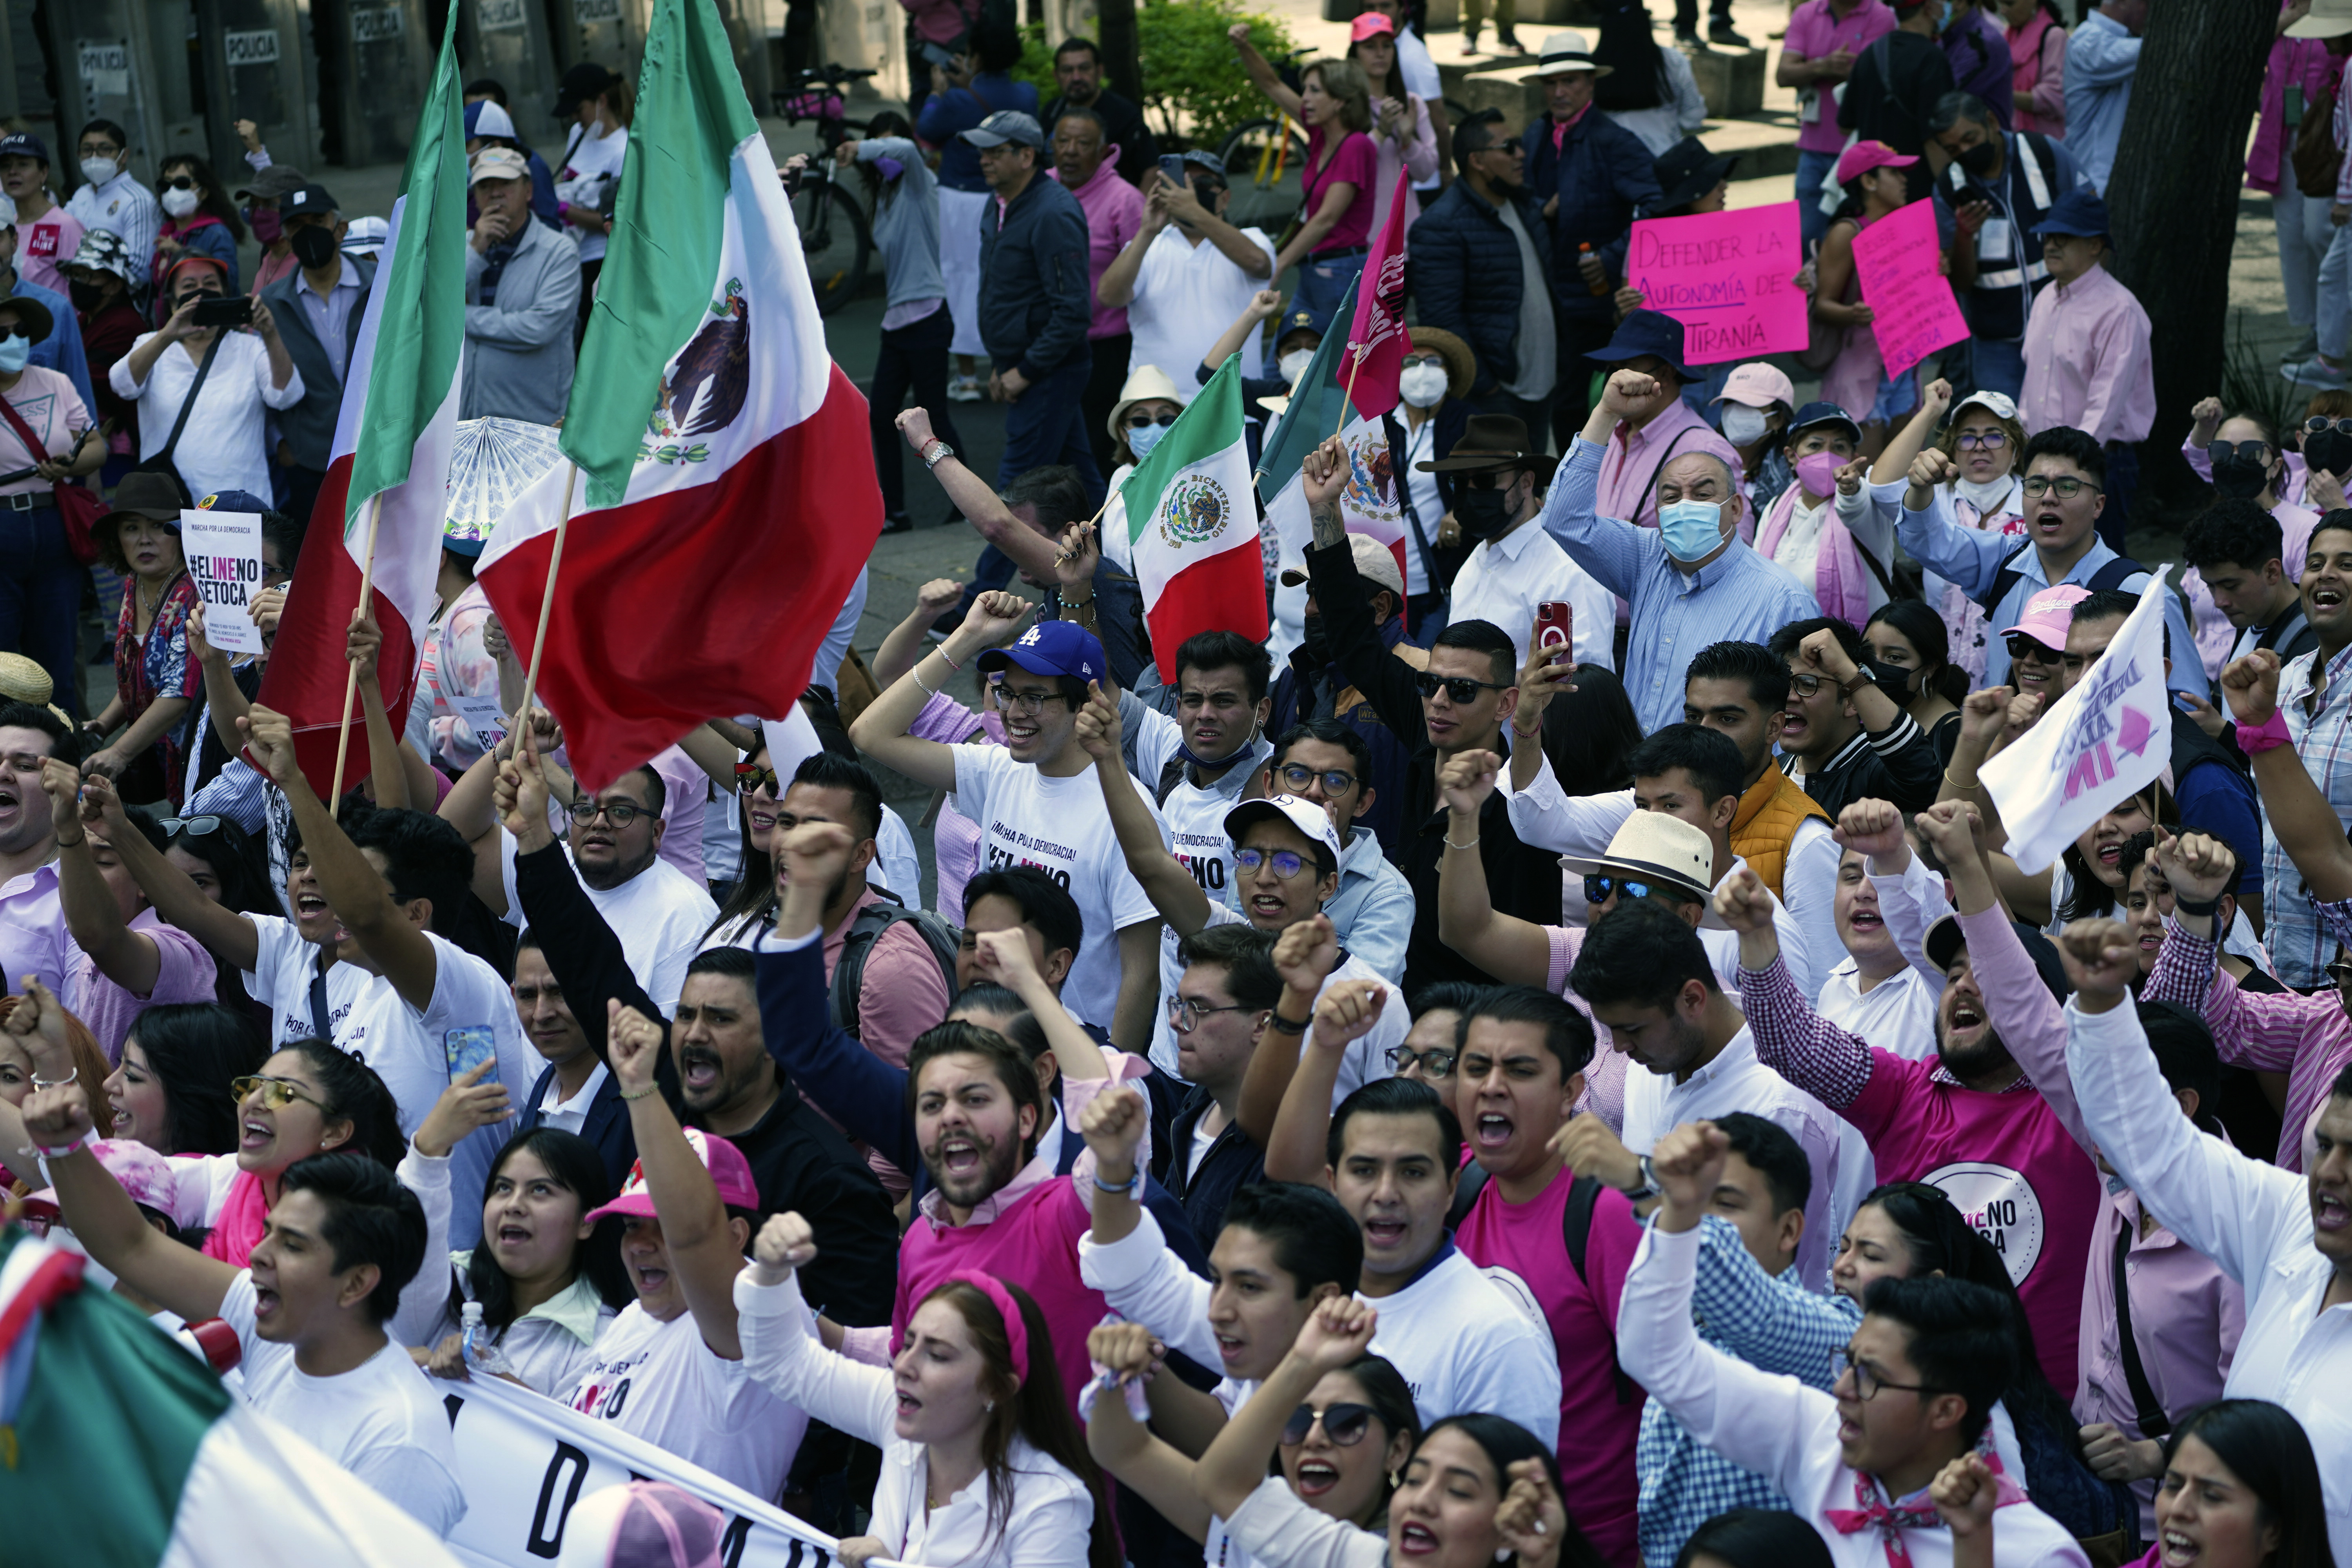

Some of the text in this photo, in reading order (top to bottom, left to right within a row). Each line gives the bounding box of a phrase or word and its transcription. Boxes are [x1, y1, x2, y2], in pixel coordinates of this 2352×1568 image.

[229, 35, 275, 59] POLICIA
[1638, 229, 1783, 268] DEFENDER LA
[1639, 271, 1785, 308] AUTONOMÍA DE
[1686, 314, 1766, 352] TIRANÍA
[1191, 475, 1230, 537] BICENTENARIO
[223, 526, 250, 534] DEMOCRACIA
[190, 555, 257, 582] #ELINENO
[198, 580, 247, 606] SETOCA
[2029, 597, 2071, 613] Dodgers
[1019, 625, 1041, 646] LA
[1361, 710, 1379, 719] Wra
[1033, 839, 1076, 862] DEMOCRACIA!
